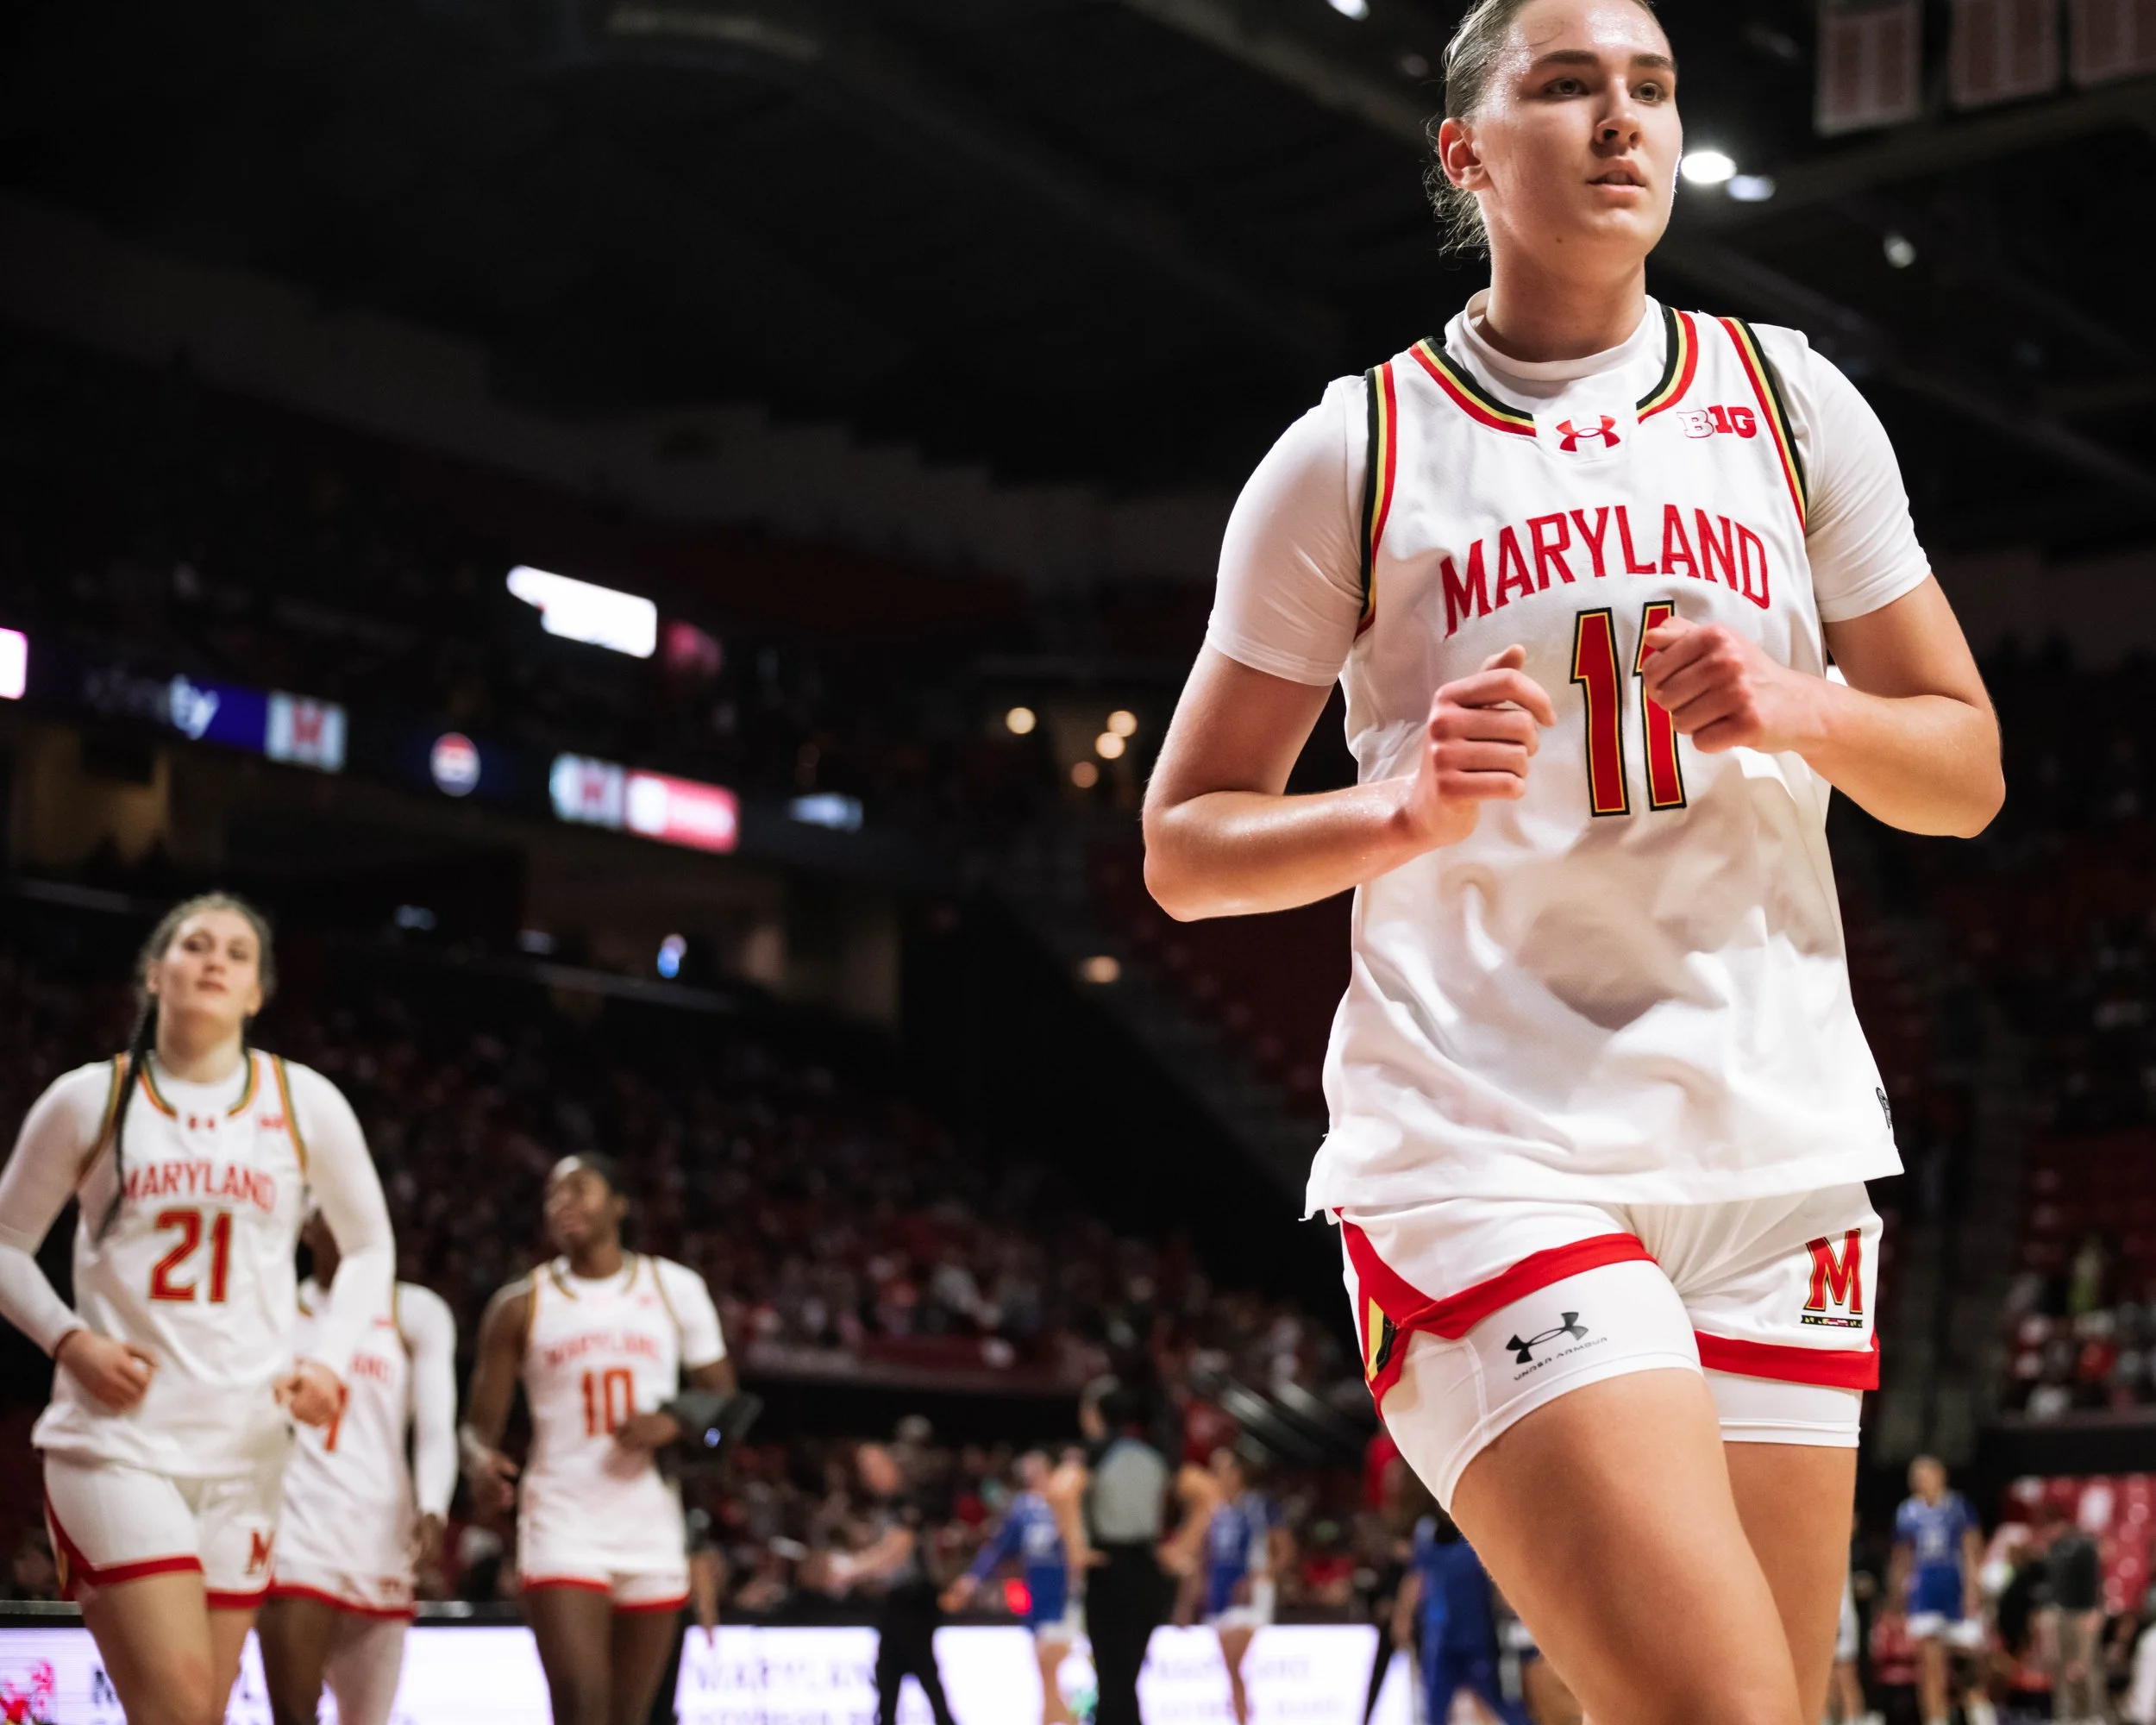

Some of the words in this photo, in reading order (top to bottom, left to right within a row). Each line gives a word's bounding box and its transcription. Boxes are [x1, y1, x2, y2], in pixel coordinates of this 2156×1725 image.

[1439, 504, 1771, 640] MARYLAND
[1570, 599, 1687, 818] 11
[148, 1208, 232, 1303] 21
[1802, 1227, 1863, 1314] M
[580, 1366, 637, 1440] 10
[1514, 1357, 1552, 1381] UNDER
[1556, 1336, 1608, 1359] ARMOUR
